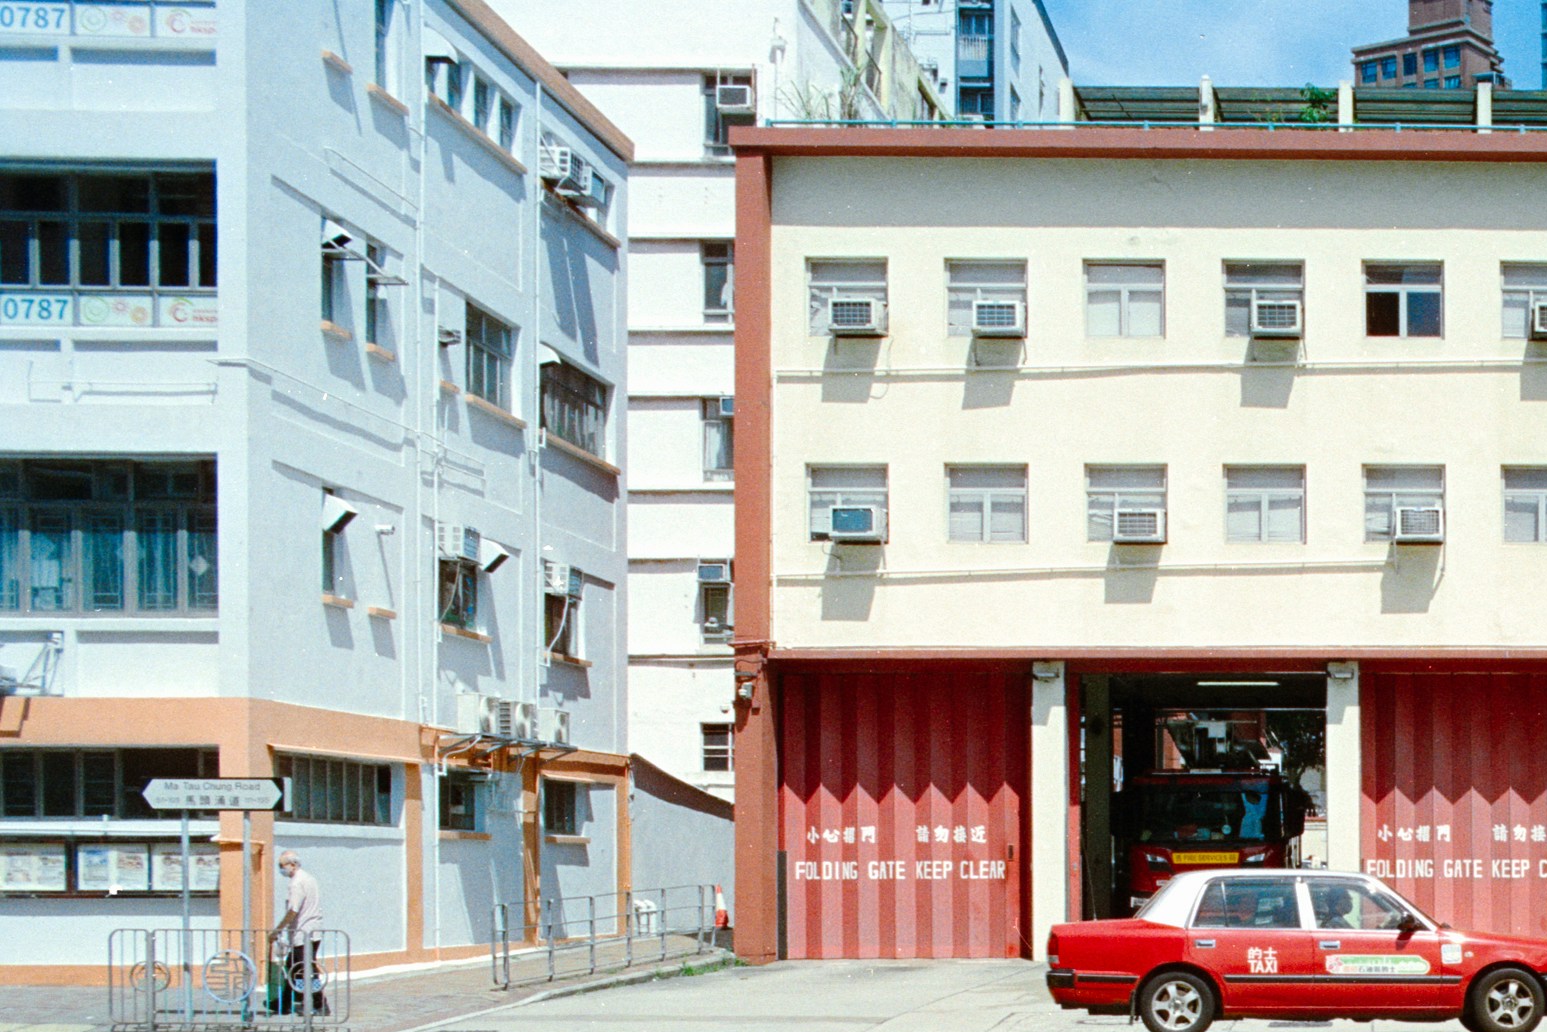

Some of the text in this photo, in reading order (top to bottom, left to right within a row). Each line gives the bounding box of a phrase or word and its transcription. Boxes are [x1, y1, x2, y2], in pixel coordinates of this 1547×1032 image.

[0, 6, 65, 28] 0787
[3, 298, 69, 320] 0787
[164, 782, 261, 792] Ma Tau Chung Road
[915, 825, 988, 844] 請勿接近
[795, 861, 1006, 880] FOLDING GATE KEEP CLEAR
[1366, 859, 1434, 878] FOLDING
[1443, 859, 1483, 878] GATE
[1491, 859, 1530, 878] KEEP
[1247, 947, 1278, 960] 的士
[1247, 960, 1278, 973] TAXI
